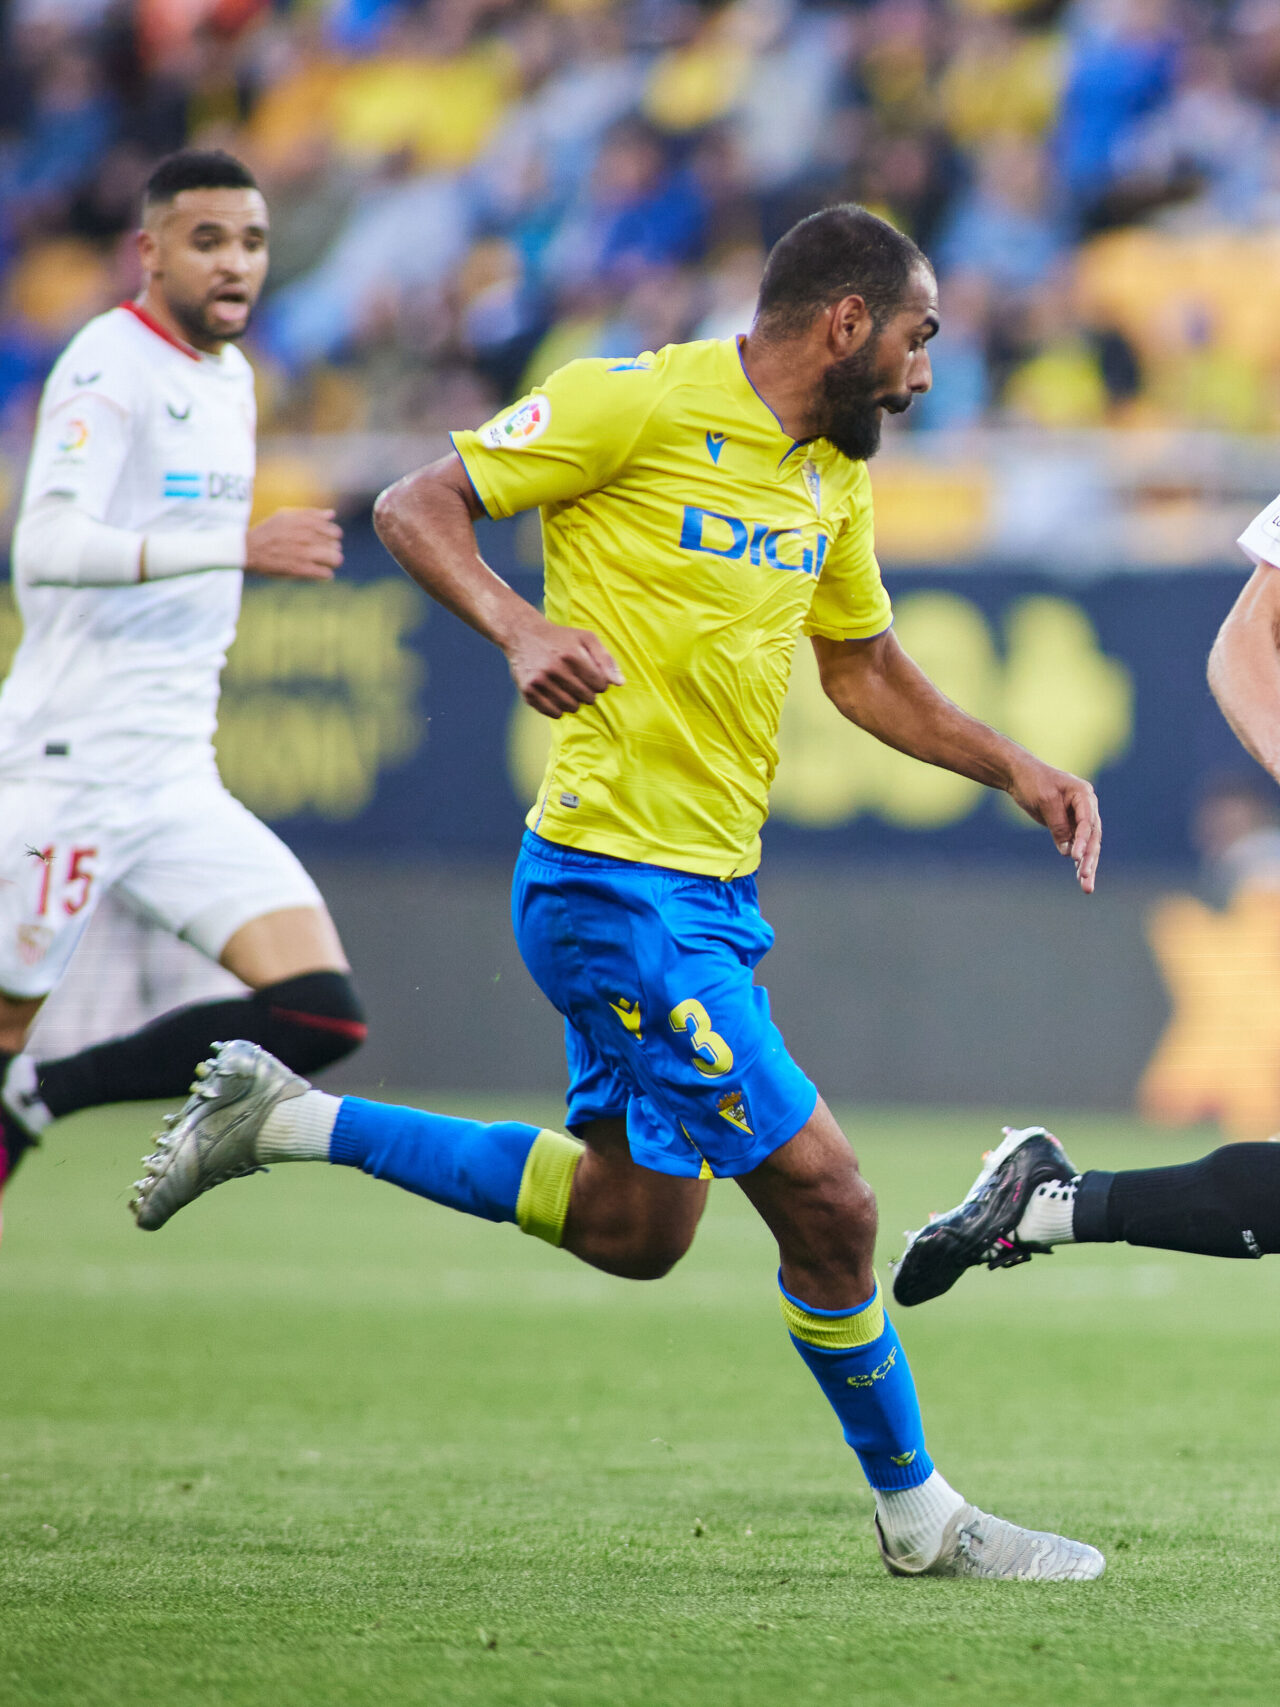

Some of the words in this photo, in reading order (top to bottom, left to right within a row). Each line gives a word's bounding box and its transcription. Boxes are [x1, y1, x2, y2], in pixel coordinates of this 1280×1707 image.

[679, 504, 828, 577] DIGI
[31, 845, 99, 916] 15
[668, 998, 734, 1079] 3
